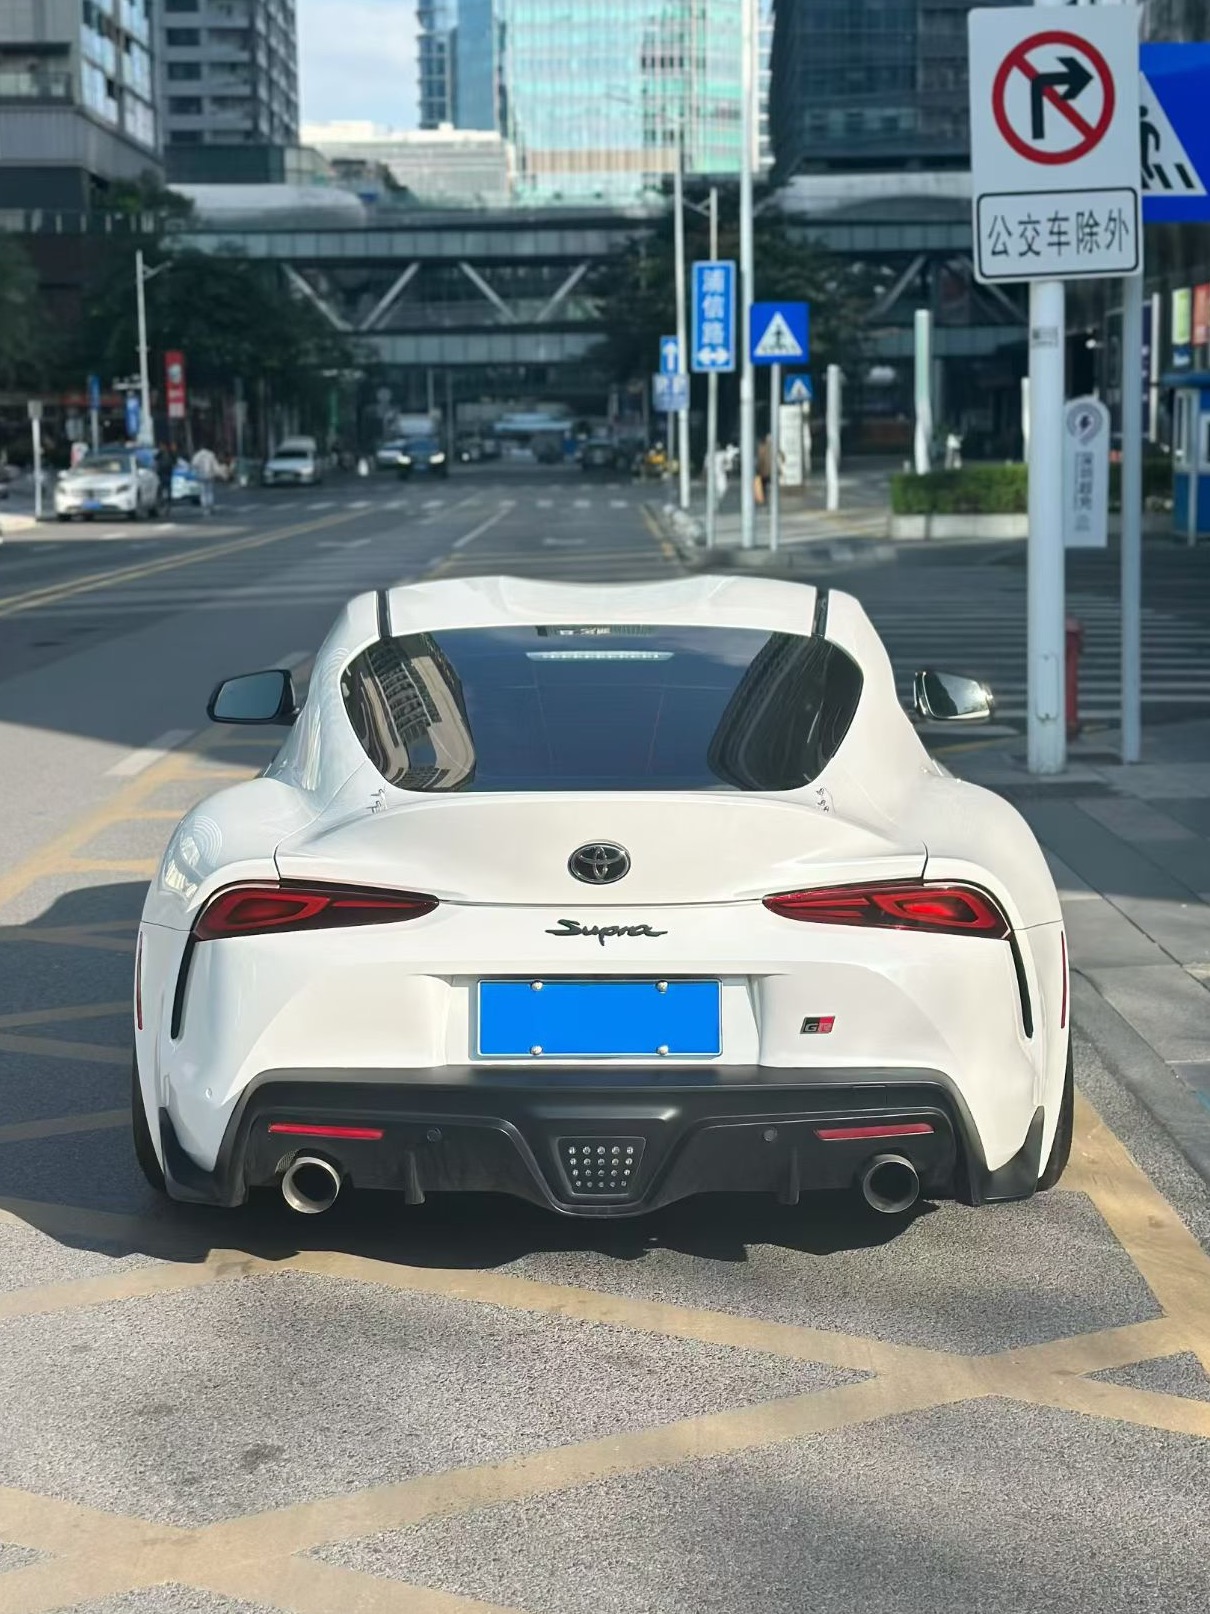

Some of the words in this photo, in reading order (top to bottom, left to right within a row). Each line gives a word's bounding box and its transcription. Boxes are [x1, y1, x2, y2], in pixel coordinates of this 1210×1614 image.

[987, 207, 1130, 258] 公交车除外
[545, 919, 668, 946] Supra
[803, 1022, 833, 1034] GR
